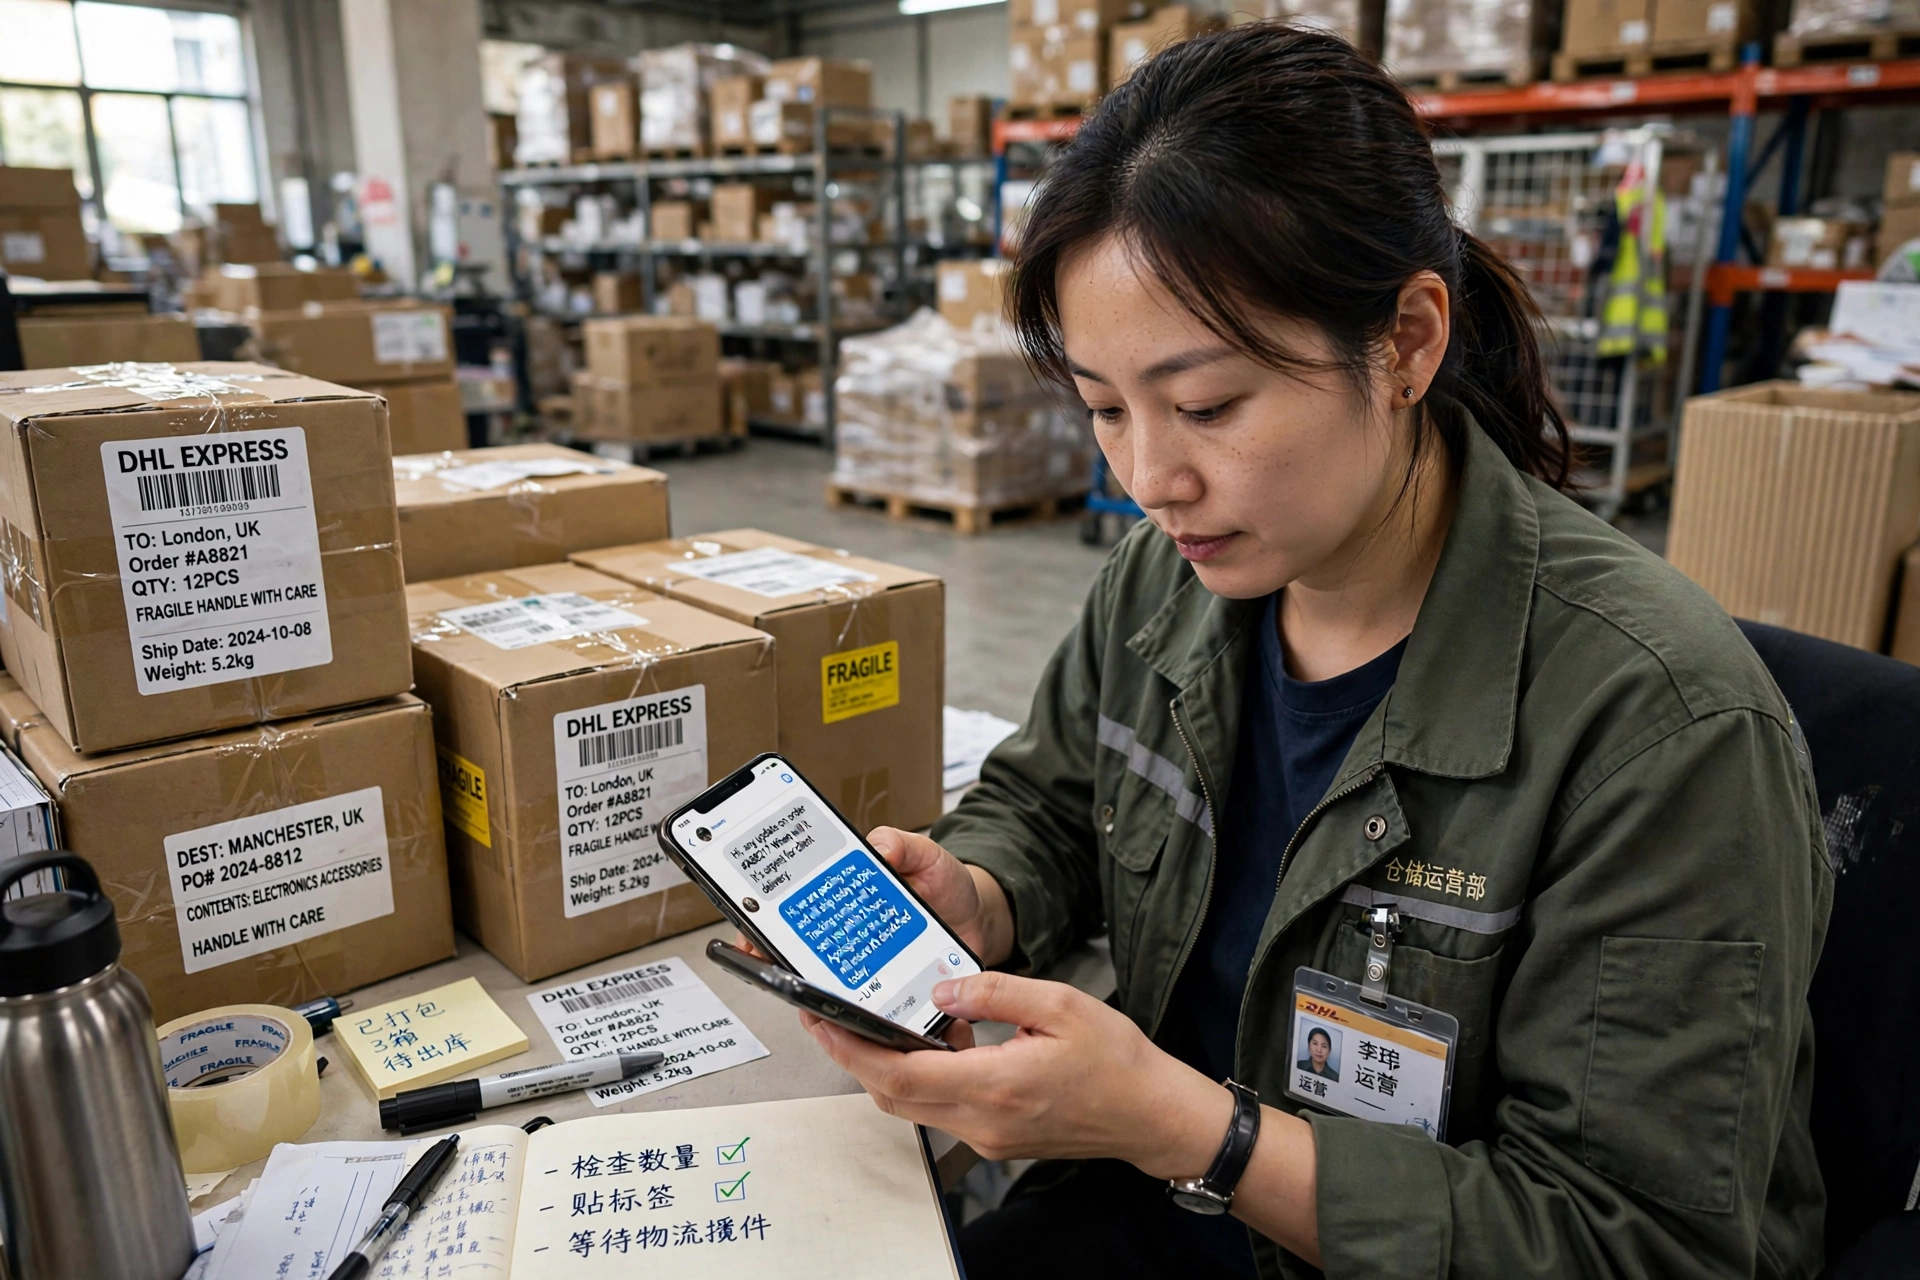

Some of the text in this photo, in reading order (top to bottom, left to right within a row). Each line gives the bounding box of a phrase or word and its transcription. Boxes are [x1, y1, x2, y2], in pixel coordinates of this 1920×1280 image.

[118, 439, 288, 473] DHL EXPRESS
[124, 520, 261, 550] TO: London, UK
[129, 545, 248, 573] Order #A8821
[132, 569, 239, 597] QTY: 12PCS
[136, 584, 318, 622] FRAGILE HANDLE WITH CARE
[142, 622, 312, 660] Ship Date: 2024-10-08
[144, 653, 254, 682] Weight: 5.2kg
[828, 651, 892, 686] FRAGILE
[567, 696, 692, 738] DHL EXPRESS
[565, 768, 654, 800] TO: London, UK
[567, 786, 651, 818] Order #A8821
[177, 808, 364, 868] DEST: MANCHESTER, UK
[568, 807, 643, 837] QTY: 12PCS
[569, 835, 612, 857] FRAGILE
[181, 847, 303, 892] PO# 2024-8812
[253, 874, 318, 905] ELECTRONICS
[320, 857, 382, 887] ACCESSORIES
[570, 872, 596, 888] Ship
[600, 863, 630, 880] Date:
[1385, 856, 1487, 900] 仓储运营部
[571, 874, 650, 906] Weight: 5.2kg
[192, 906, 325, 957] HANDLE WITH CARE
[541, 988, 584, 1004] DHL
[586, 964, 672, 992] EXPRESS
[355, 1002, 445, 1034] 已打包
[556, 1022, 581, 1034] TO:
[584, 1007, 640, 1026] London,
[642, 999, 664, 1008] UK
[563, 1011, 659, 1044] Order #A8821
[180, 1022, 234, 1044] FRAGILE
[235, 1040, 280, 1053] FRAGILE
[371, 1028, 419, 1053] 3箱
[570, 1025, 658, 1056] QTY: 12PCS
[628, 1033, 671, 1054] HANDLE
[672, 1027, 701, 1041] WITH
[703, 1017, 733, 1032] CARE
[200, 1056, 255, 1073] FRAGILE
[383, 1032, 472, 1072] 待出库
[663, 1038, 736, 1067] 2024-10-08
[595, 1079, 650, 1100] Weight:
[653, 1065, 693, 1083] 5.2kg
[1298, 1075, 1328, 1098] 运营
[1354, 1064, 1398, 1097] 运营
[571, 1184, 675, 1217] 贴标签
